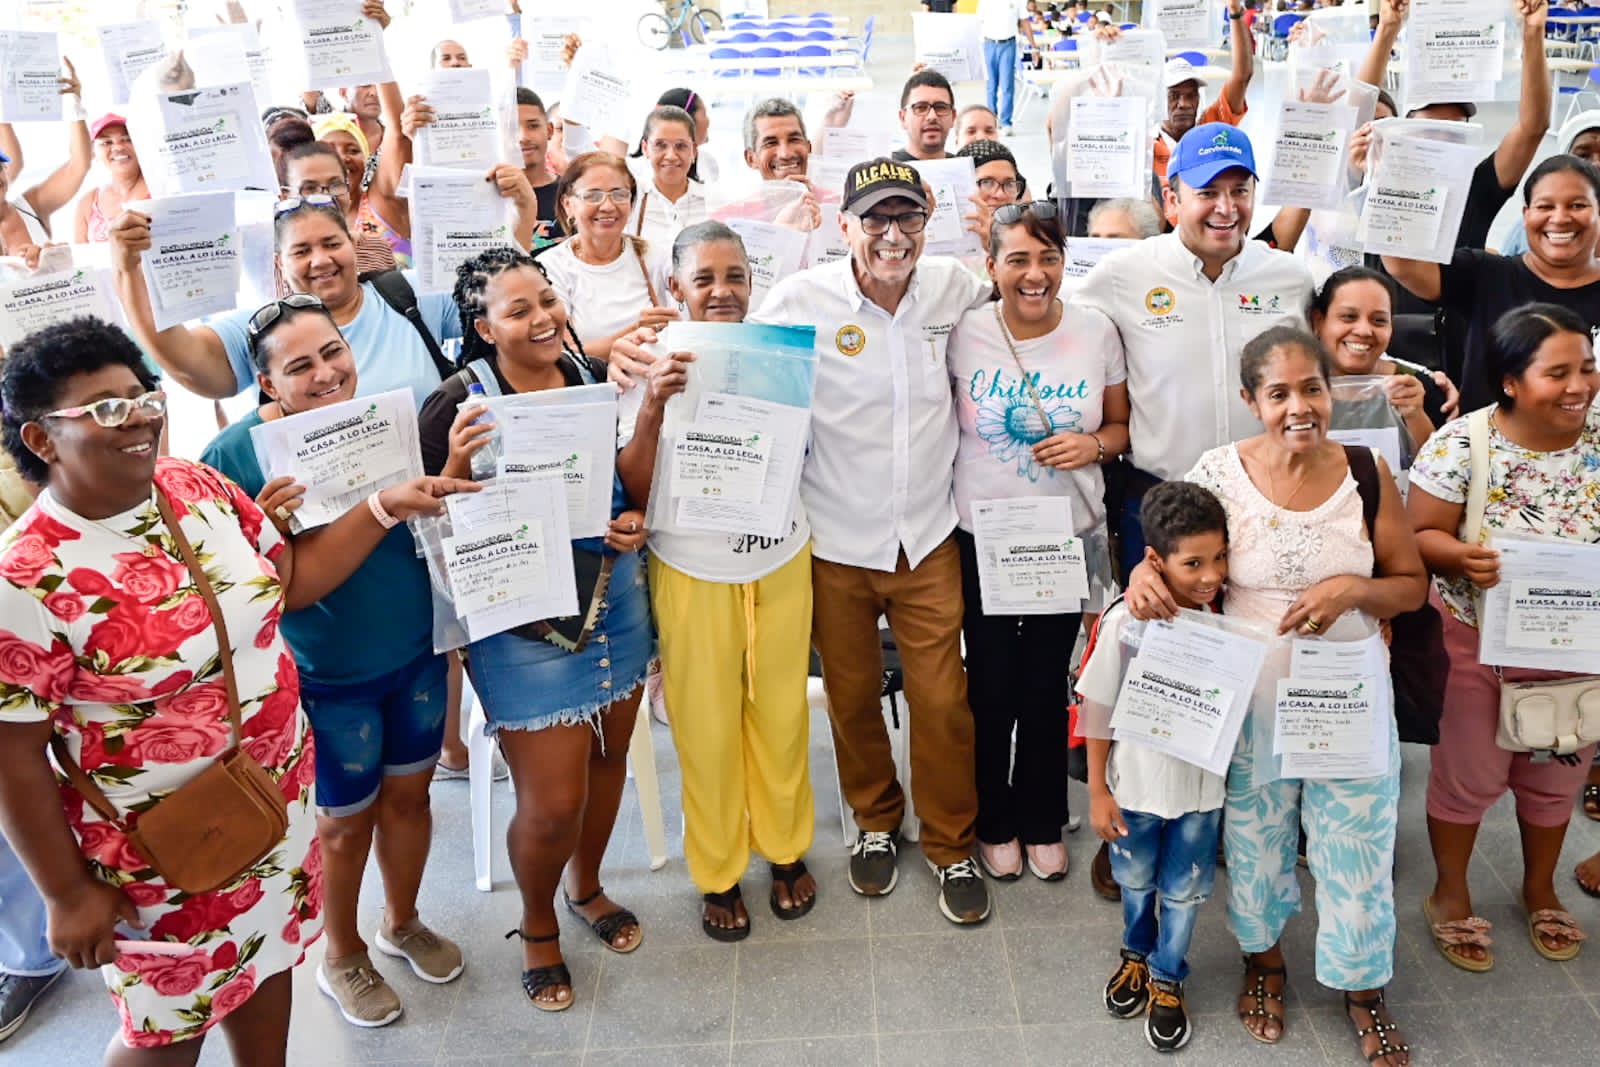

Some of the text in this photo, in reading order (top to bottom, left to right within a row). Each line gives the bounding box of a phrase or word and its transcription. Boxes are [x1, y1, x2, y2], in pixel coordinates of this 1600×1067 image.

[856, 163, 913, 186] ALCALDE
[347, 429, 360, 439] LO
[361, 419, 391, 433] LEGAL
[723, 448, 735, 456] LO
[737, 450, 764, 461] LEGAL
[496, 546, 508, 555] LO
[510, 542, 539, 552] LEGAL
[1179, 695, 1192, 704] LO
[1193, 700, 1222, 716] LEGAL
[1343, 700, 1369, 709] LEGAL
